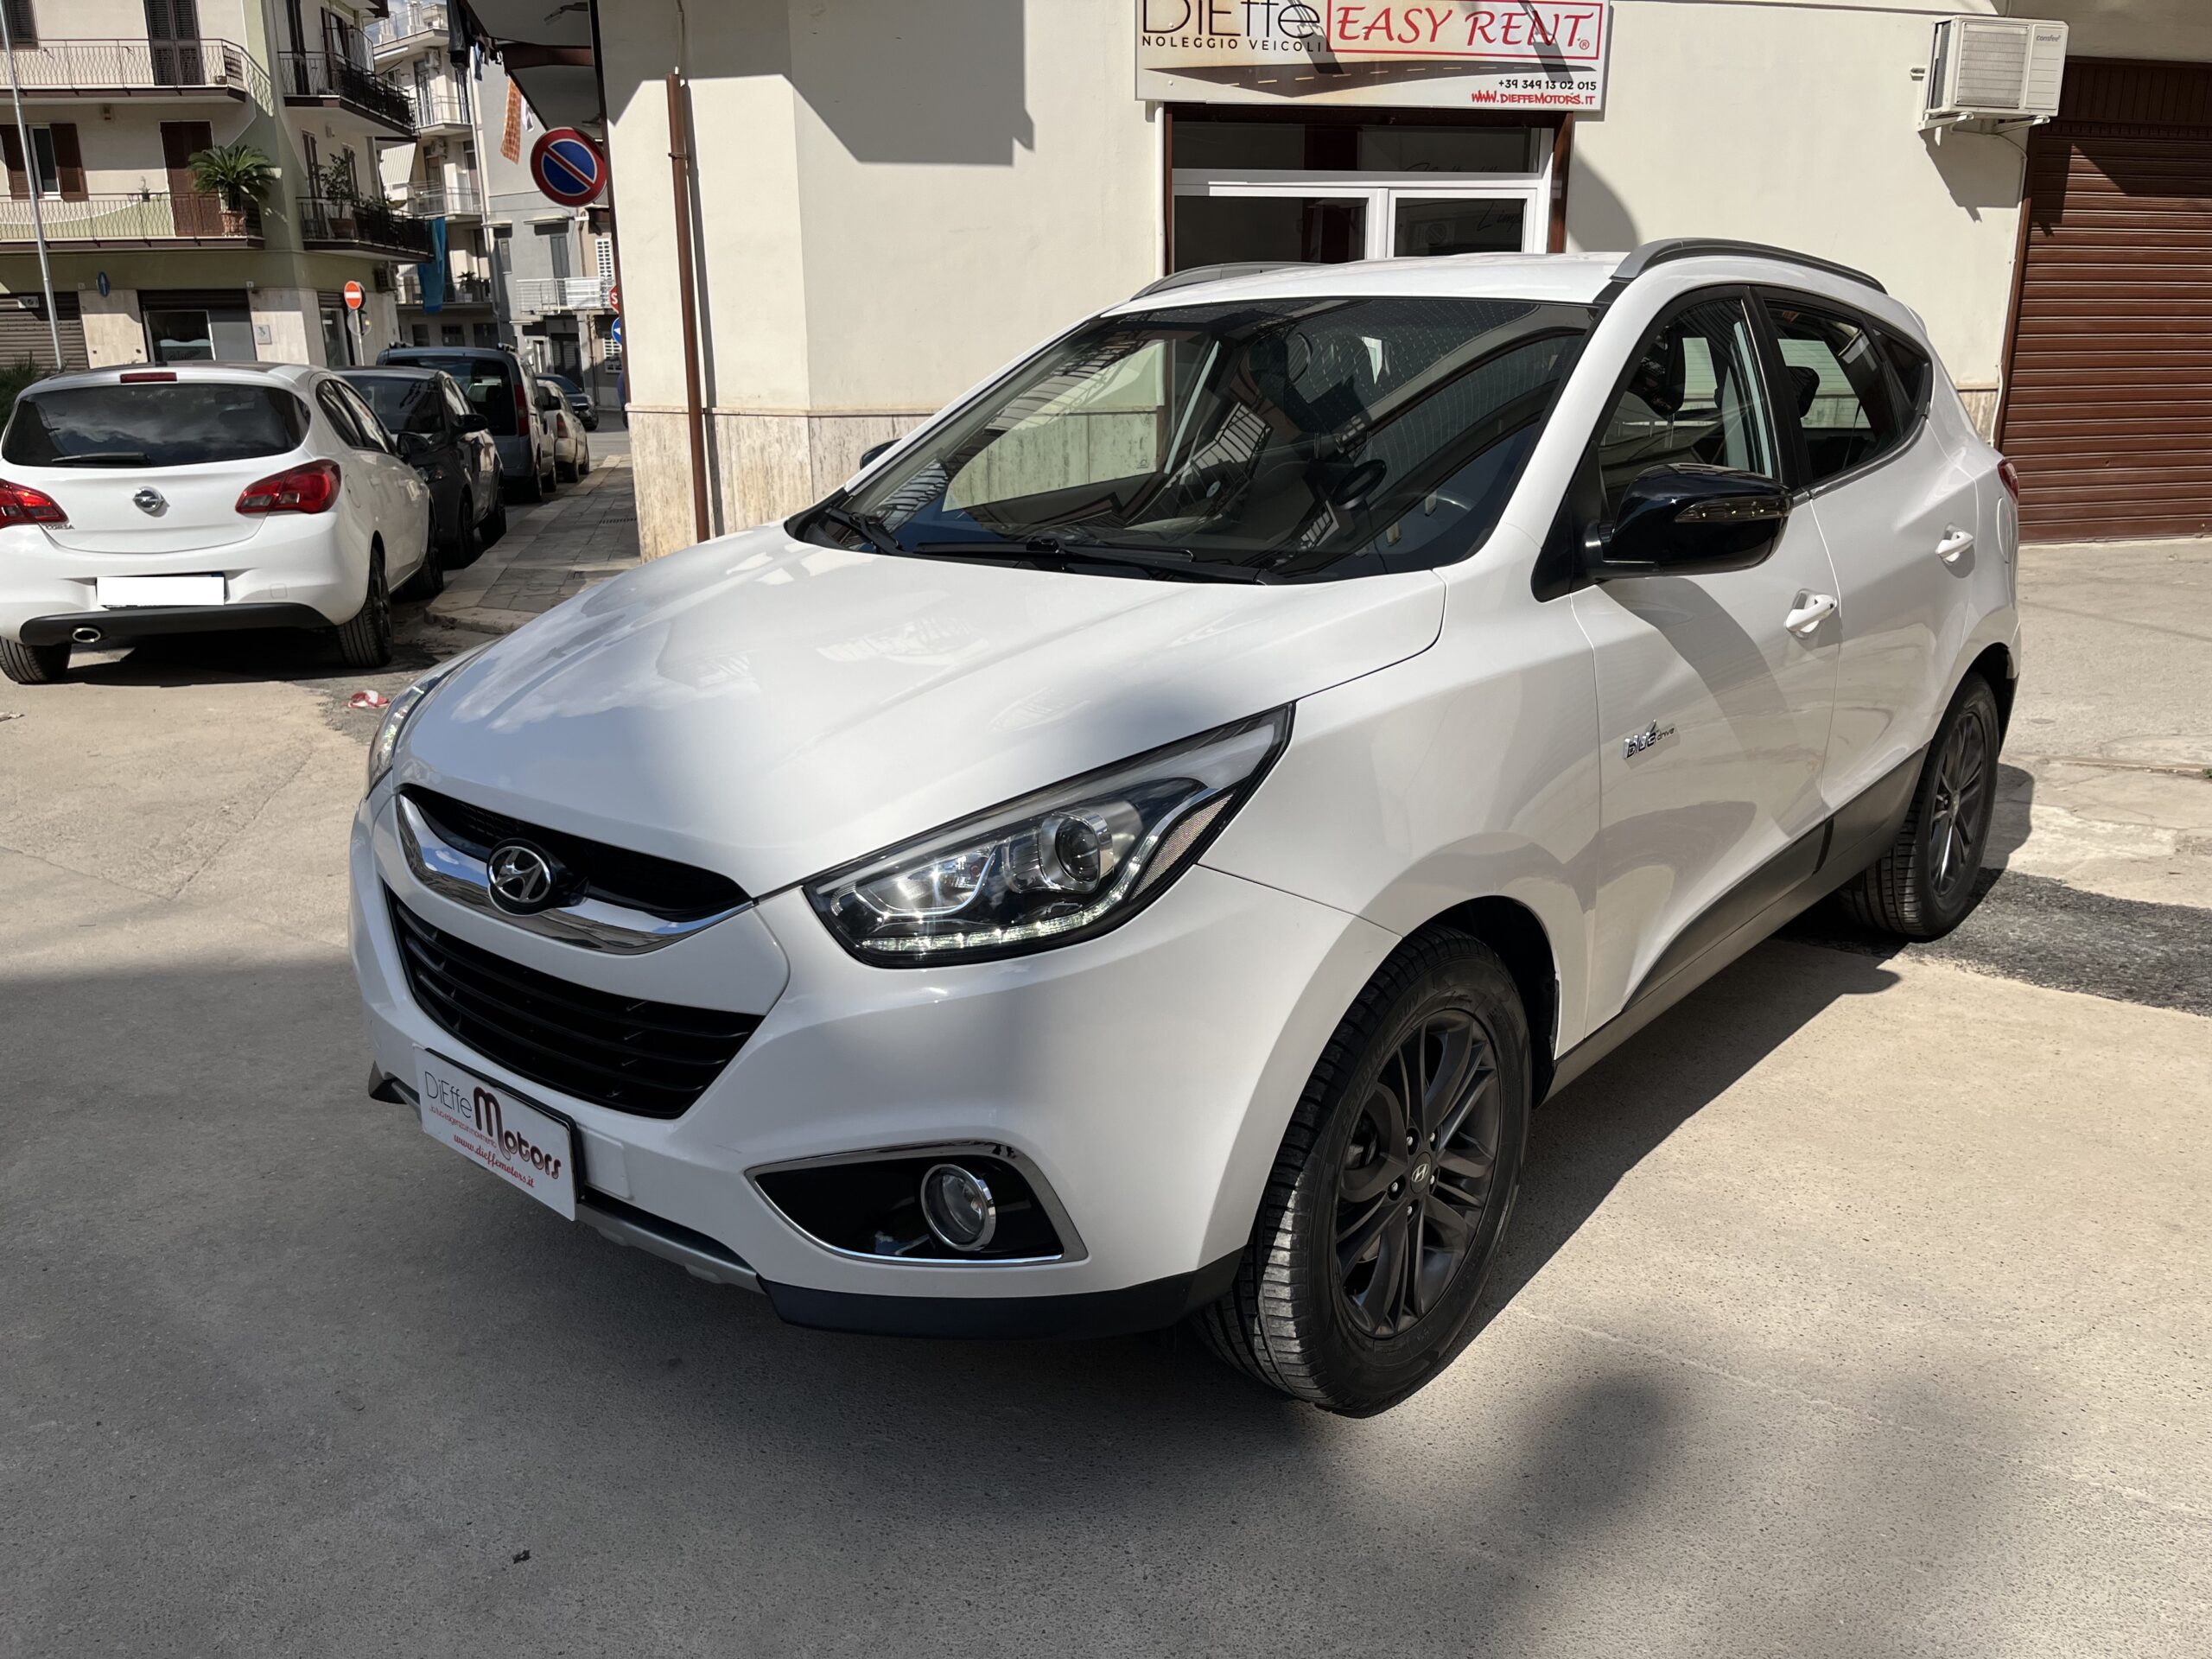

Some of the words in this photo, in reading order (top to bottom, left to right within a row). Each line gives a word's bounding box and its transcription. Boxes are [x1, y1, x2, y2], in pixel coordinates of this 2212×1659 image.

[1337, 6, 1452, 44] EASY
[1141, 35, 1238, 49] NOLEGGIO
[1249, 39, 1321, 52] VEICOLI
[1498, 79, 1518, 89] +39
[1522, 79, 1542, 89] 349
[1545, 79, 1556, 90] 13
[1560, 80, 1573, 90] 02
[1577, 80, 1597, 91] 015
